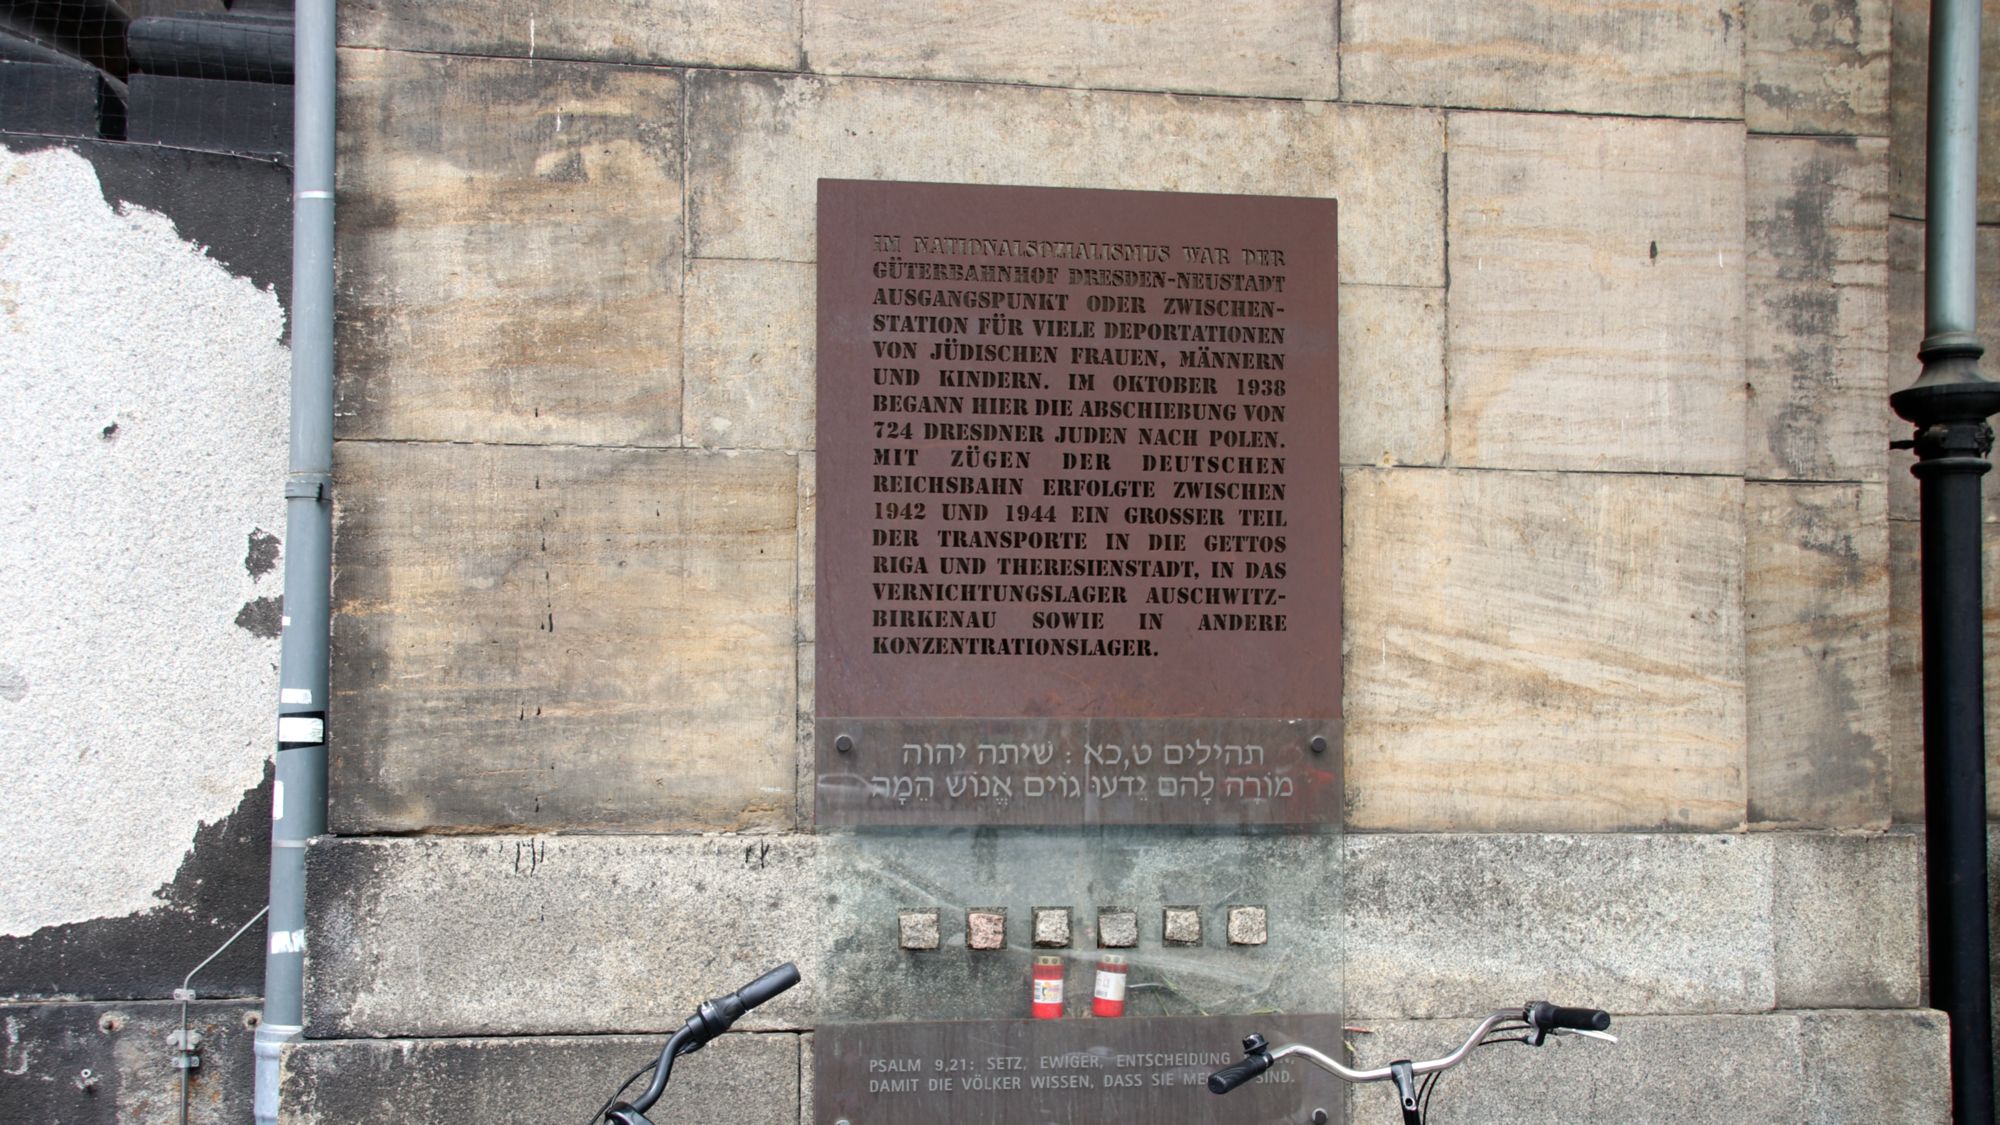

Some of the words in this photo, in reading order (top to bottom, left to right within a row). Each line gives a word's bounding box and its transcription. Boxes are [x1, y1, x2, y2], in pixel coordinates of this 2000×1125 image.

[874, 235, 901, 251] IM
[915, 236, 1170, 262] NATIONALSOZIALISMUS
[1183, 247, 1230, 264] WAR
[1242, 249, 1286, 267] DER
[873, 257, 1058, 284] GÜTERBAHNHOF
[1069, 268, 1286, 293] DRESDEN-NEUSTADT
[872, 288, 1069, 311] AUSGANGSPUNKT
[1087, 295, 1146, 313] ODER
[1163, 298, 1284, 318] ZWISCHEN-
[873, 314, 968, 334] STATION
[978, 313, 1024, 336] FÜR
[1032, 320, 1095, 338] VIELE
[1104, 322, 1285, 344] DEPORTATIONEN
[872, 341, 918, 359] VON
[930, 338, 1058, 363] JÜDISCHEN
[1071, 347, 1166, 368] FRAUEN,
[1179, 346, 1285, 370] MÄNNERN
[873, 368, 920, 386] UND
[939, 370, 1049, 390] KINDERN.
[1068, 373, 1095, 391] IM
[1113, 375, 1218, 394] OKTOBER
[1237, 379, 1286, 396] 1938
[873, 394, 964, 414] BEGANN
[972, 397, 1029, 416] HIER
[1035, 399, 1072, 416] DIE
[1079, 400, 1237, 421] ABSCHIEBUNG
[1242, 404, 1285, 422] VON
[874, 421, 913, 440] 724
[923, 422, 1045, 443] DRESDNER
[1055, 426, 1127, 444] JUDEN
[1138, 428, 1198, 446] NACH
[1209, 430, 1285, 448] POLEN.
[873, 448, 919, 466] MIT
[951, 445, 1031, 469] ZÜGEN
[1063, 453, 1111, 471] DER
[1142, 454, 1286, 474] DEUTSCHEN
[873, 475, 1024, 495] REICHSBAHN
[1043, 479, 1155, 498] ERFOLGTE
[1173, 481, 1286, 501] ZWISCHEN
[875, 502, 926, 520] 1942
[941, 503, 988, 521] UND
[1006, 505, 1056, 523] 1944
[1072, 506, 1109, 523] EIN
[1124, 507, 1225, 526] GROSSER
[1238, 509, 1287, 527] TEIL
[872, 529, 920, 547] DER
[937, 530, 1087, 550] TRANSPORTE
[1106, 533, 1130, 550] IN
[1148, 534, 1186, 551] DIE
[1204, 535, 1286, 553] GETTOS
[873, 556, 929, 574] RIGA
[939, 557, 986, 575] UND
[997, 558, 1199, 580] THERESIENSTADT,
[1211, 561, 1235, 579] IN
[1245, 562, 1286, 579] DAS
[872, 583, 1127, 603] VERNICHTUNGSLAGER
[1145, 587, 1286, 605] AUSCHWITZ-
[872, 610, 997, 629] BIRKENAU
[1032, 611, 1104, 629] SOWIE
[1139, 613, 1164, 630] IN
[1197, 614, 1287, 631] ANDERE
[872, 637, 1158, 656] KONZENTRATIONSLAGER.
[903, 741, 965, 764] יהוה
[1165, 738, 1263, 766] תהילים
[870, 1058, 921, 1072] PSALM
[935, 1057, 974, 1072] 9,21:
[987, 1055, 1027, 1071] SETZ,
[1040, 1054, 1104, 1070] EWIGER,
[1117, 1052, 1230, 1068] ENTSCHEIDUNG
[870, 1078, 920, 1093] DAMIT
[929, 1077, 954, 1092] DIE
[962, 1073, 1021, 1091] VÖLKER
[1031, 1074, 1094, 1090] WISSEN,
[1104, 1073, 1142, 1088] DASS
[1152, 1072, 1174, 1087] SIE
[1256, 1068, 1295, 1084] SIND.
